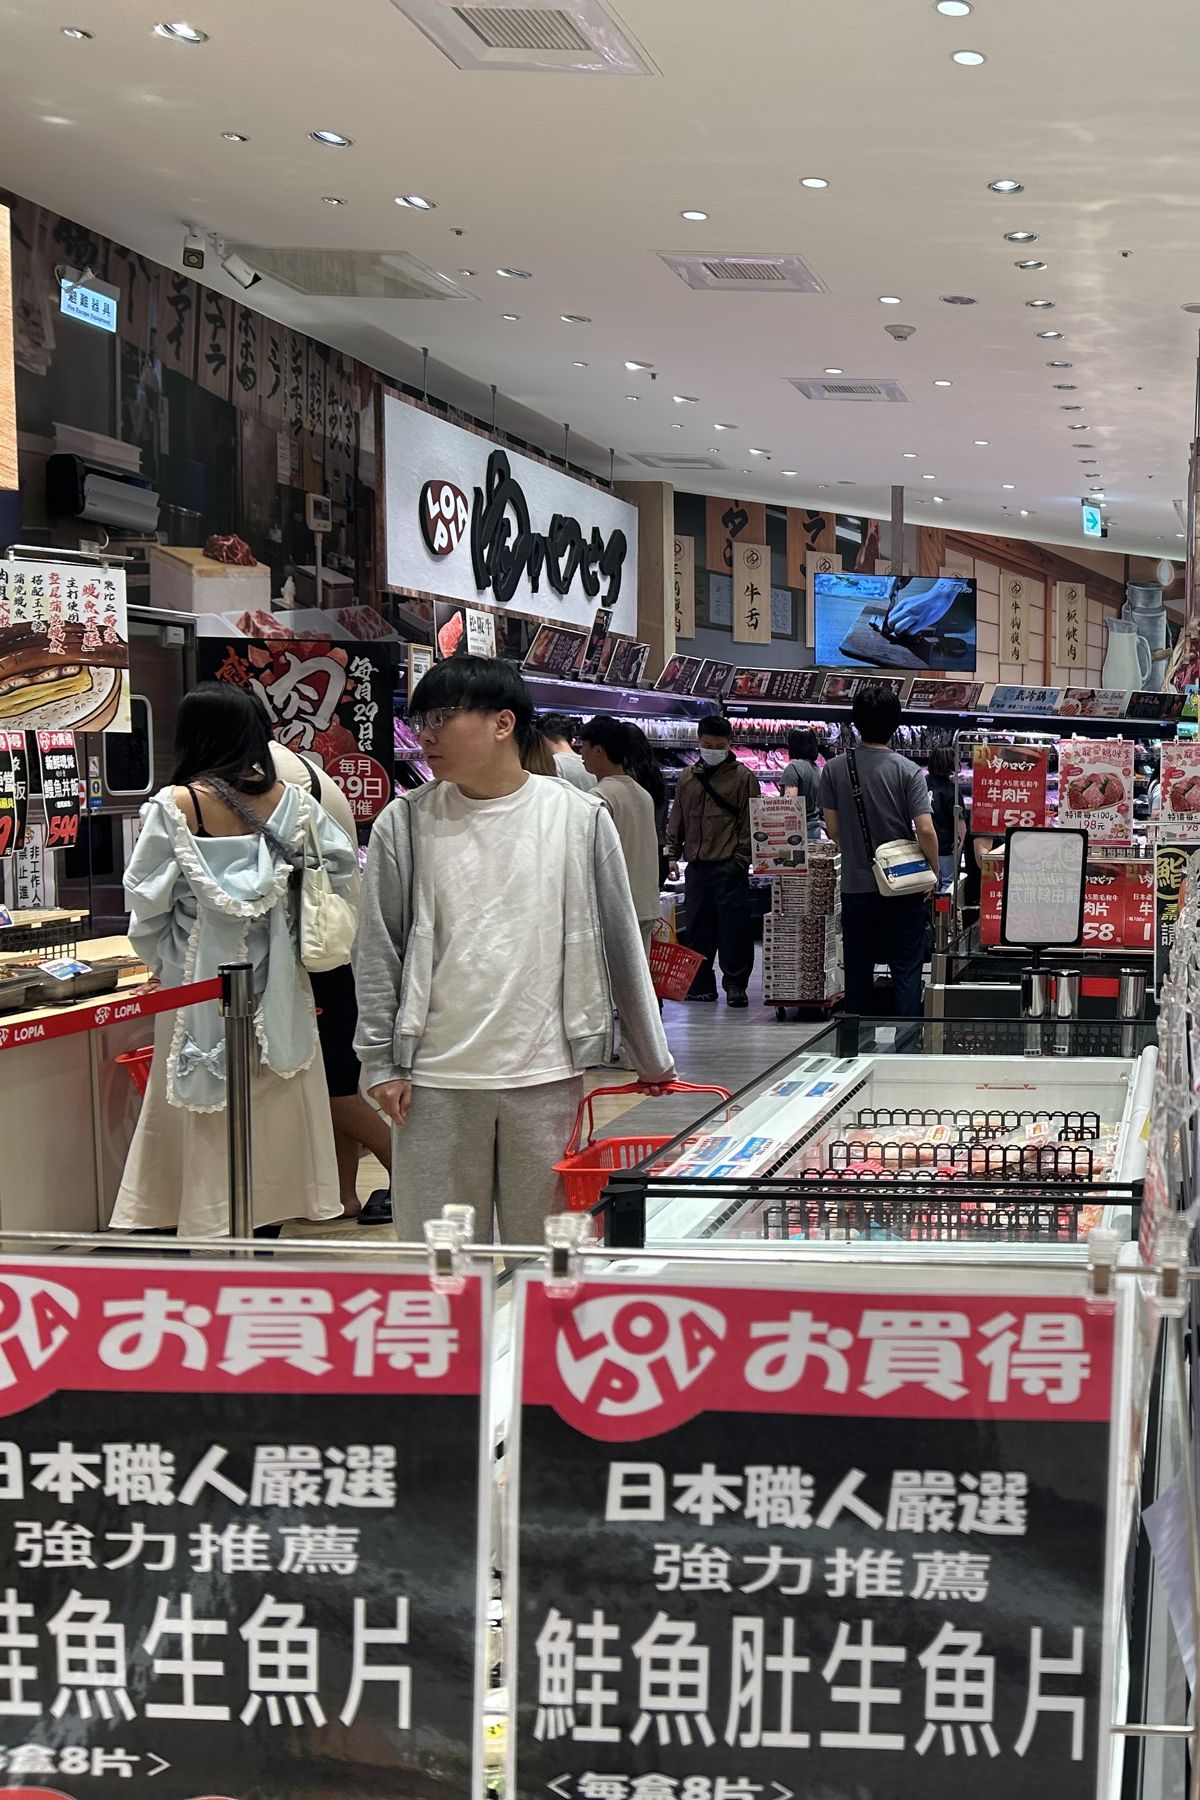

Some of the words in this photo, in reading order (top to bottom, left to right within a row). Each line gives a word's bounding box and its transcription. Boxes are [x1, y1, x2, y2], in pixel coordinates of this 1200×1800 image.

[744, 582, 761, 630] 牛舌
[986, 754, 1036, 774] 肉のロピア
[987, 786, 1031, 804] 牛肉片
[991, 808, 1037, 828] 158
[13, 1023, 45, 1042] LOPIA
[114, 1002, 142, 1019] LOPIA
[98, 1287, 461, 1379] お買得
[744, 1309, 1092, 1404] お買得
[604, 1461, 1029, 1536] 日本職人嚴選
[13, 1519, 361, 1576] 強力推薦
[651, 1541, 992, 1603] 強力推薦
[531, 1607, 1087, 1762] 鮭魚肚生魚片
[0, 1742, 172, 1778] 盒8片>
